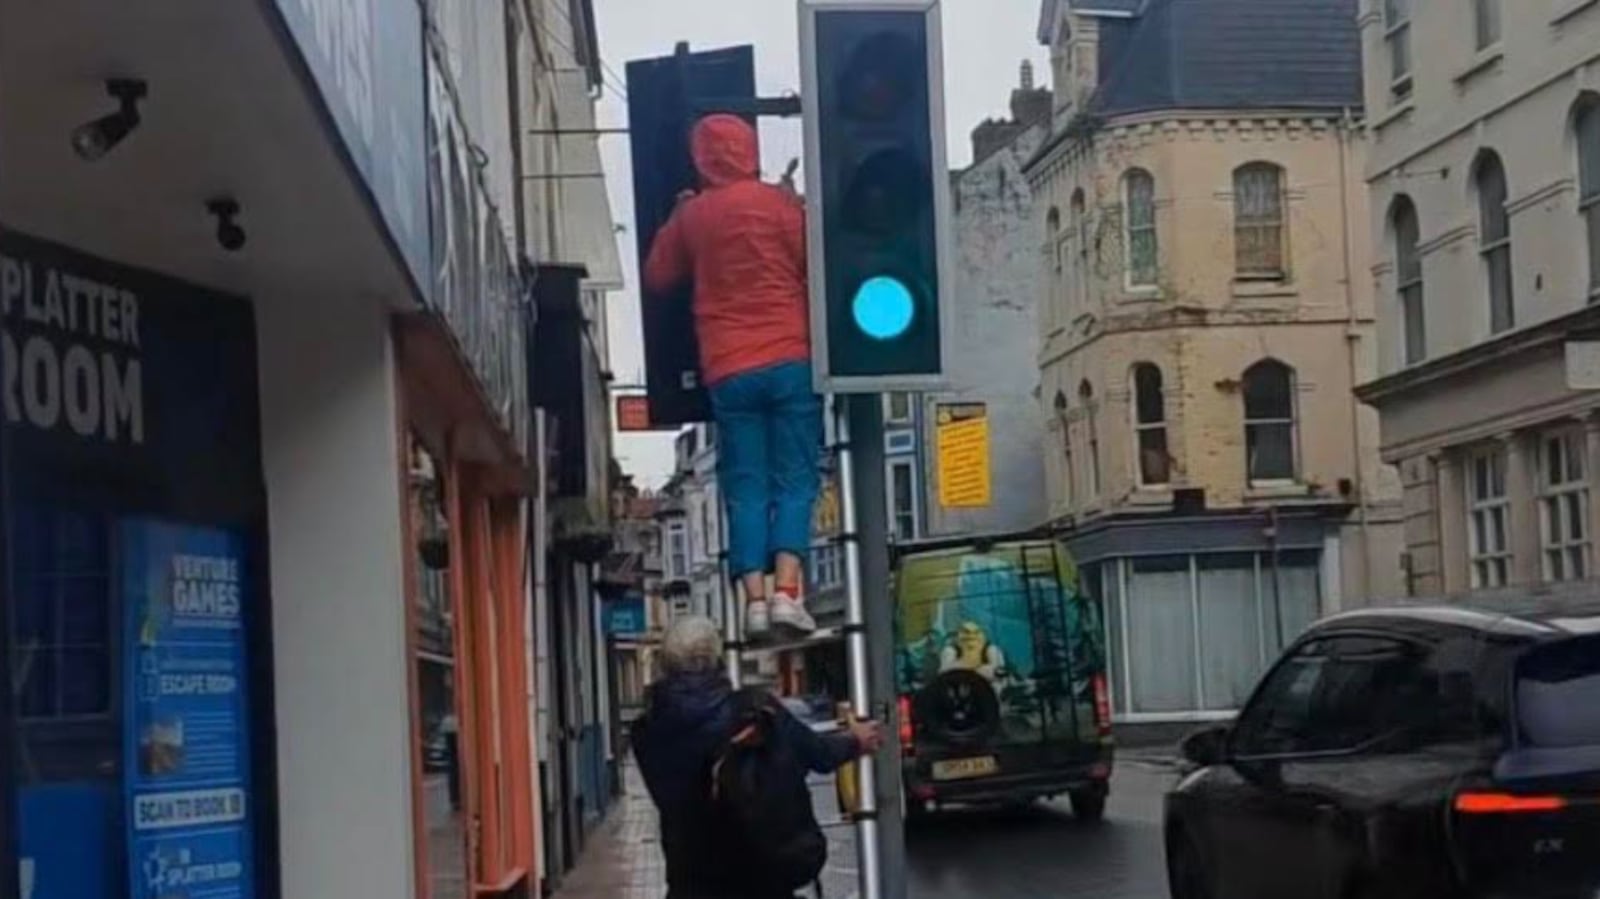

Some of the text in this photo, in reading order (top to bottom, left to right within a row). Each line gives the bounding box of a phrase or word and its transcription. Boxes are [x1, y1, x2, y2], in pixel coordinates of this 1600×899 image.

[173, 580, 240, 617] GAMES
[160, 674, 206, 695] ESCAPE
[140, 799, 174, 822] SCAN
